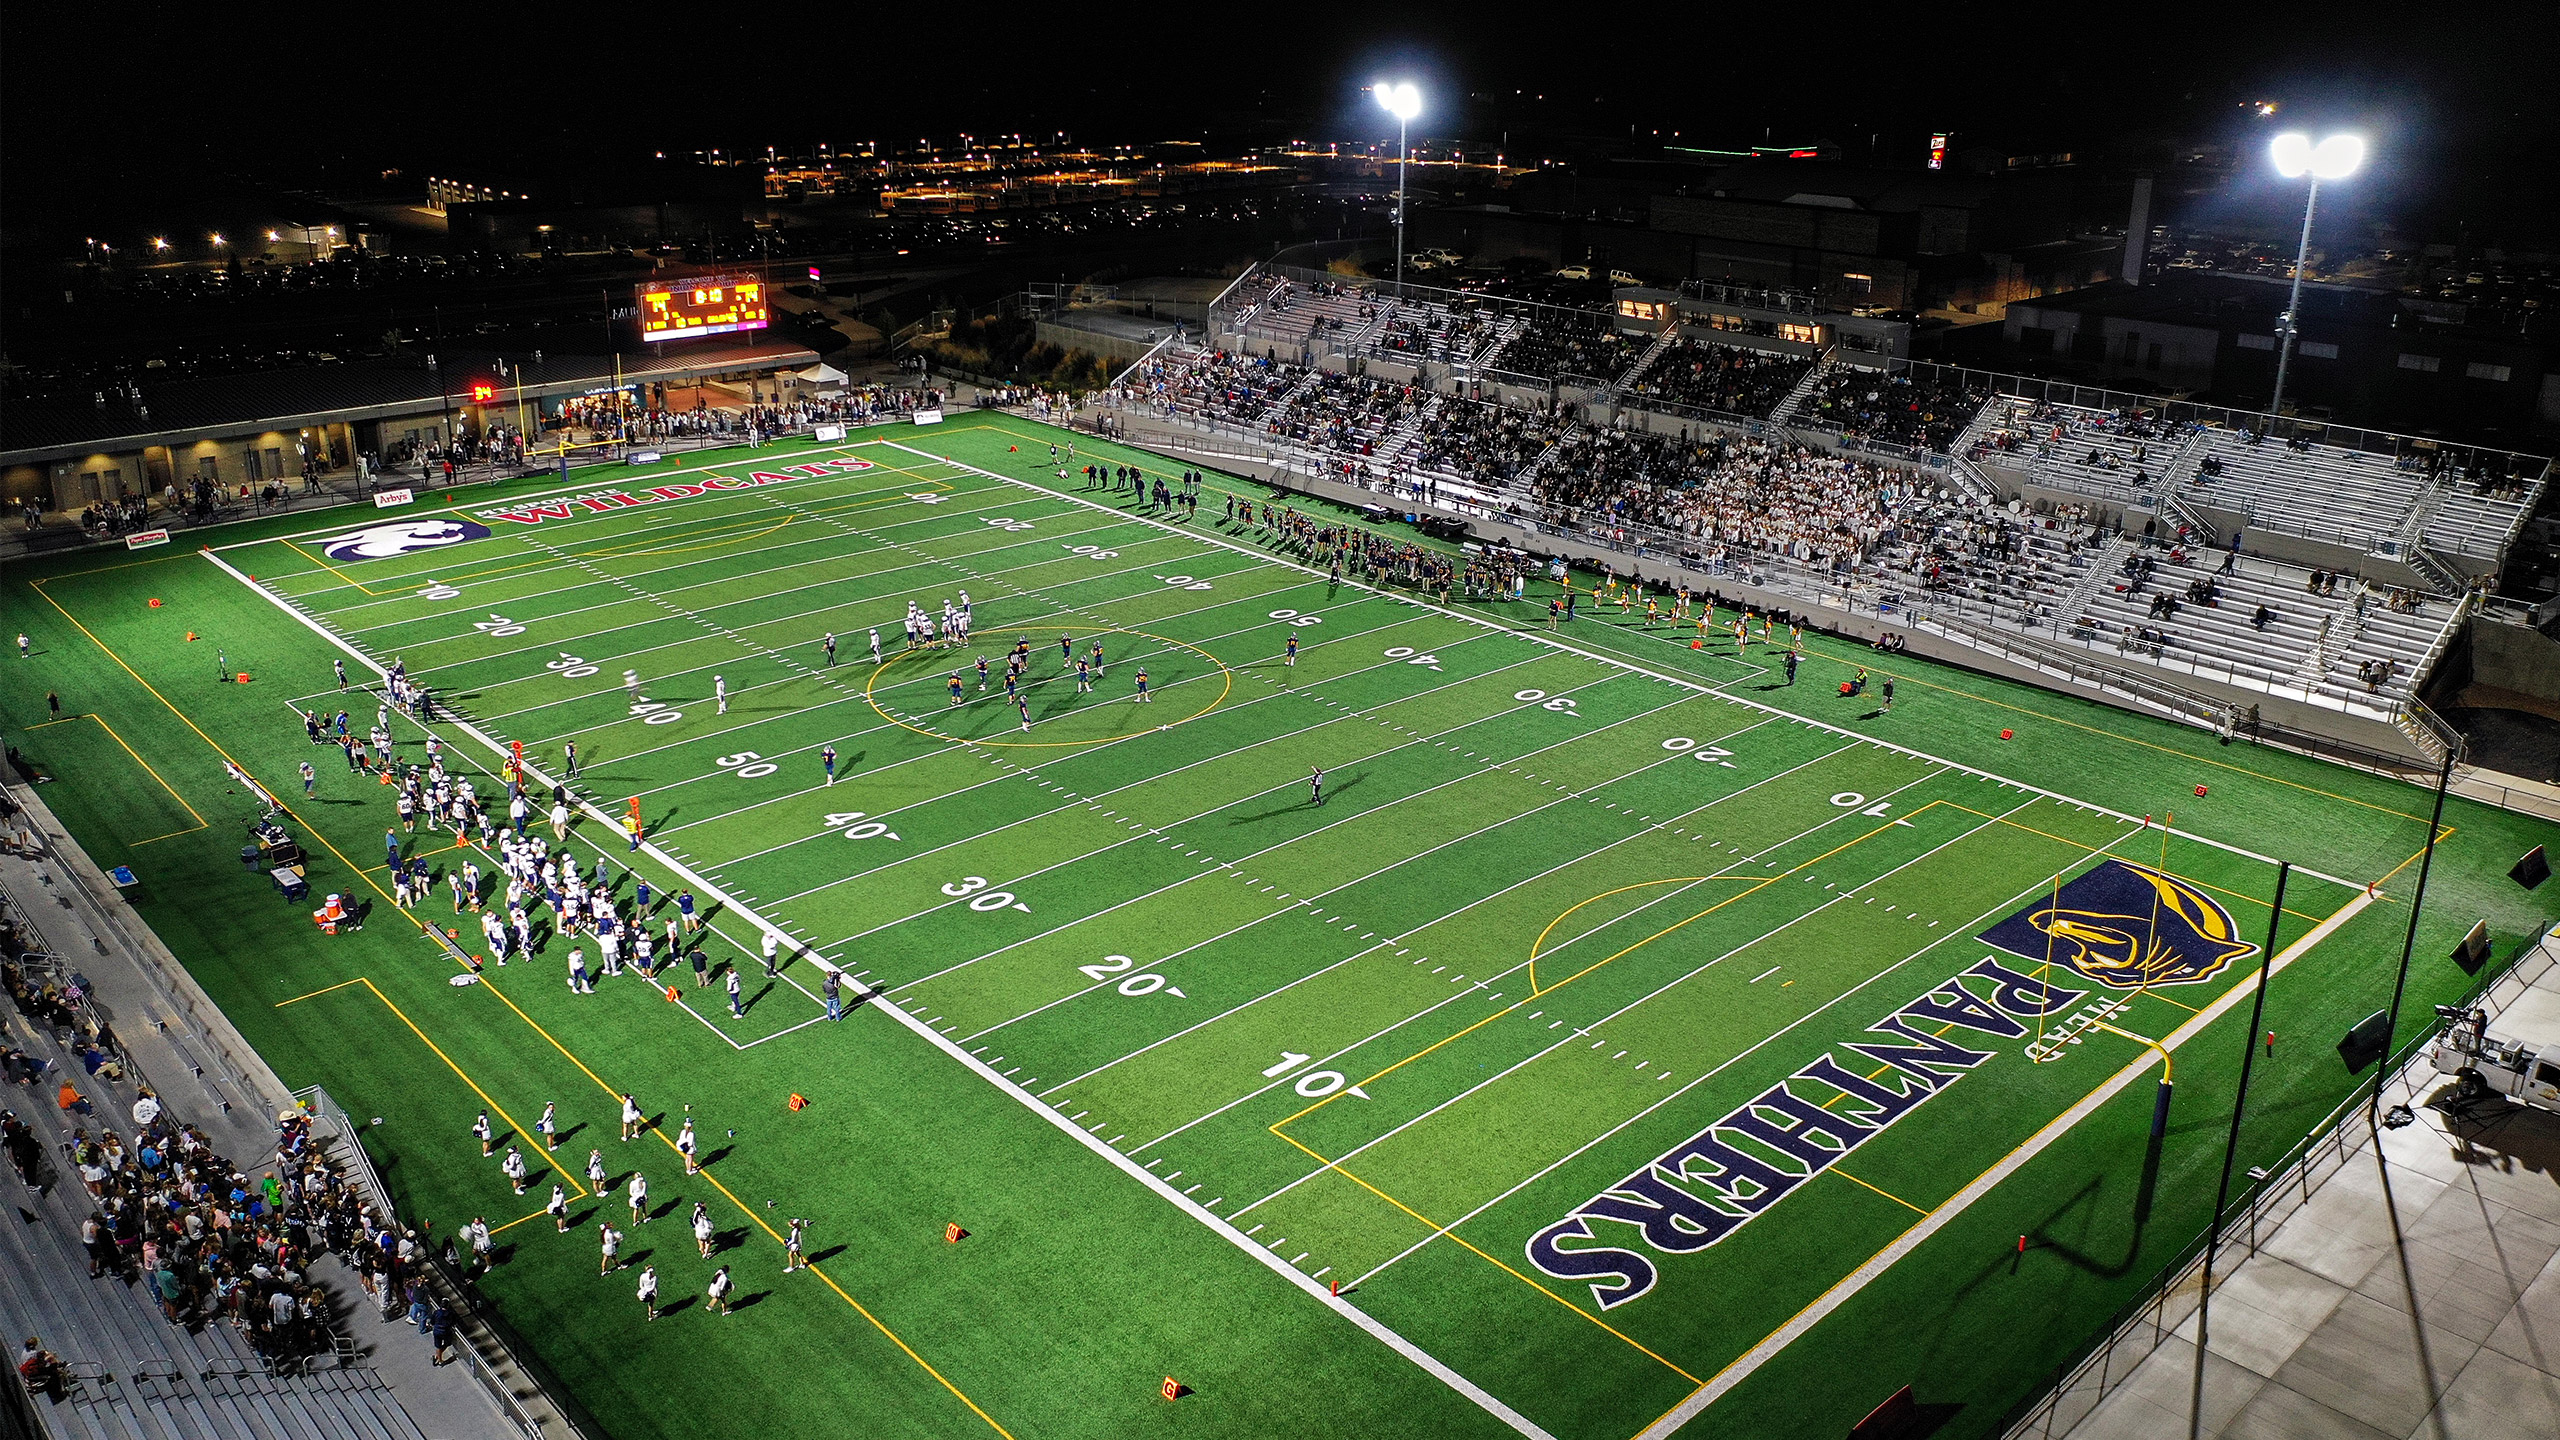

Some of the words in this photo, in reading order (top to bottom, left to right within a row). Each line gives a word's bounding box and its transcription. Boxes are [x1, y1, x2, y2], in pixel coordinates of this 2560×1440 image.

[668, 284, 696, 292] UNION
[698, 280, 738, 290] STADIUM
[678, 276, 714, 285] WELCOME
[380, 492, 408, 504] Arby's
[489, 457, 876, 525] WILDCATS
[912, 493, 949, 504] 10
[987, 516, 1035, 532] 20
[1072, 544, 1119, 560] 30
[416, 583, 461, 600] 10
[1164, 574, 1214, 591] 40
[472, 618, 526, 637] 20
[1268, 609, 1322, 627] 50
[1384, 646, 1440, 664] 40
[546, 656, 600, 678] 30
[1514, 688, 1577, 712] 30
[628, 704, 682, 725] 40
[1661, 736, 1734, 762] 20
[716, 750, 778, 778] 50
[1829, 792, 1893, 818] 10
[823, 811, 888, 840] 40
[940, 876, 1016, 912] 30
[1077, 954, 1166, 997] 20
[2024, 995, 2132, 1062] MEAD
[1261, 1051, 1346, 1098] 10
[790, 1095, 800, 1110] 20
[1524, 954, 2090, 1311] PANTHERS
[947, 1224, 957, 1242] 10
[1164, 1380, 1174, 1398] G
